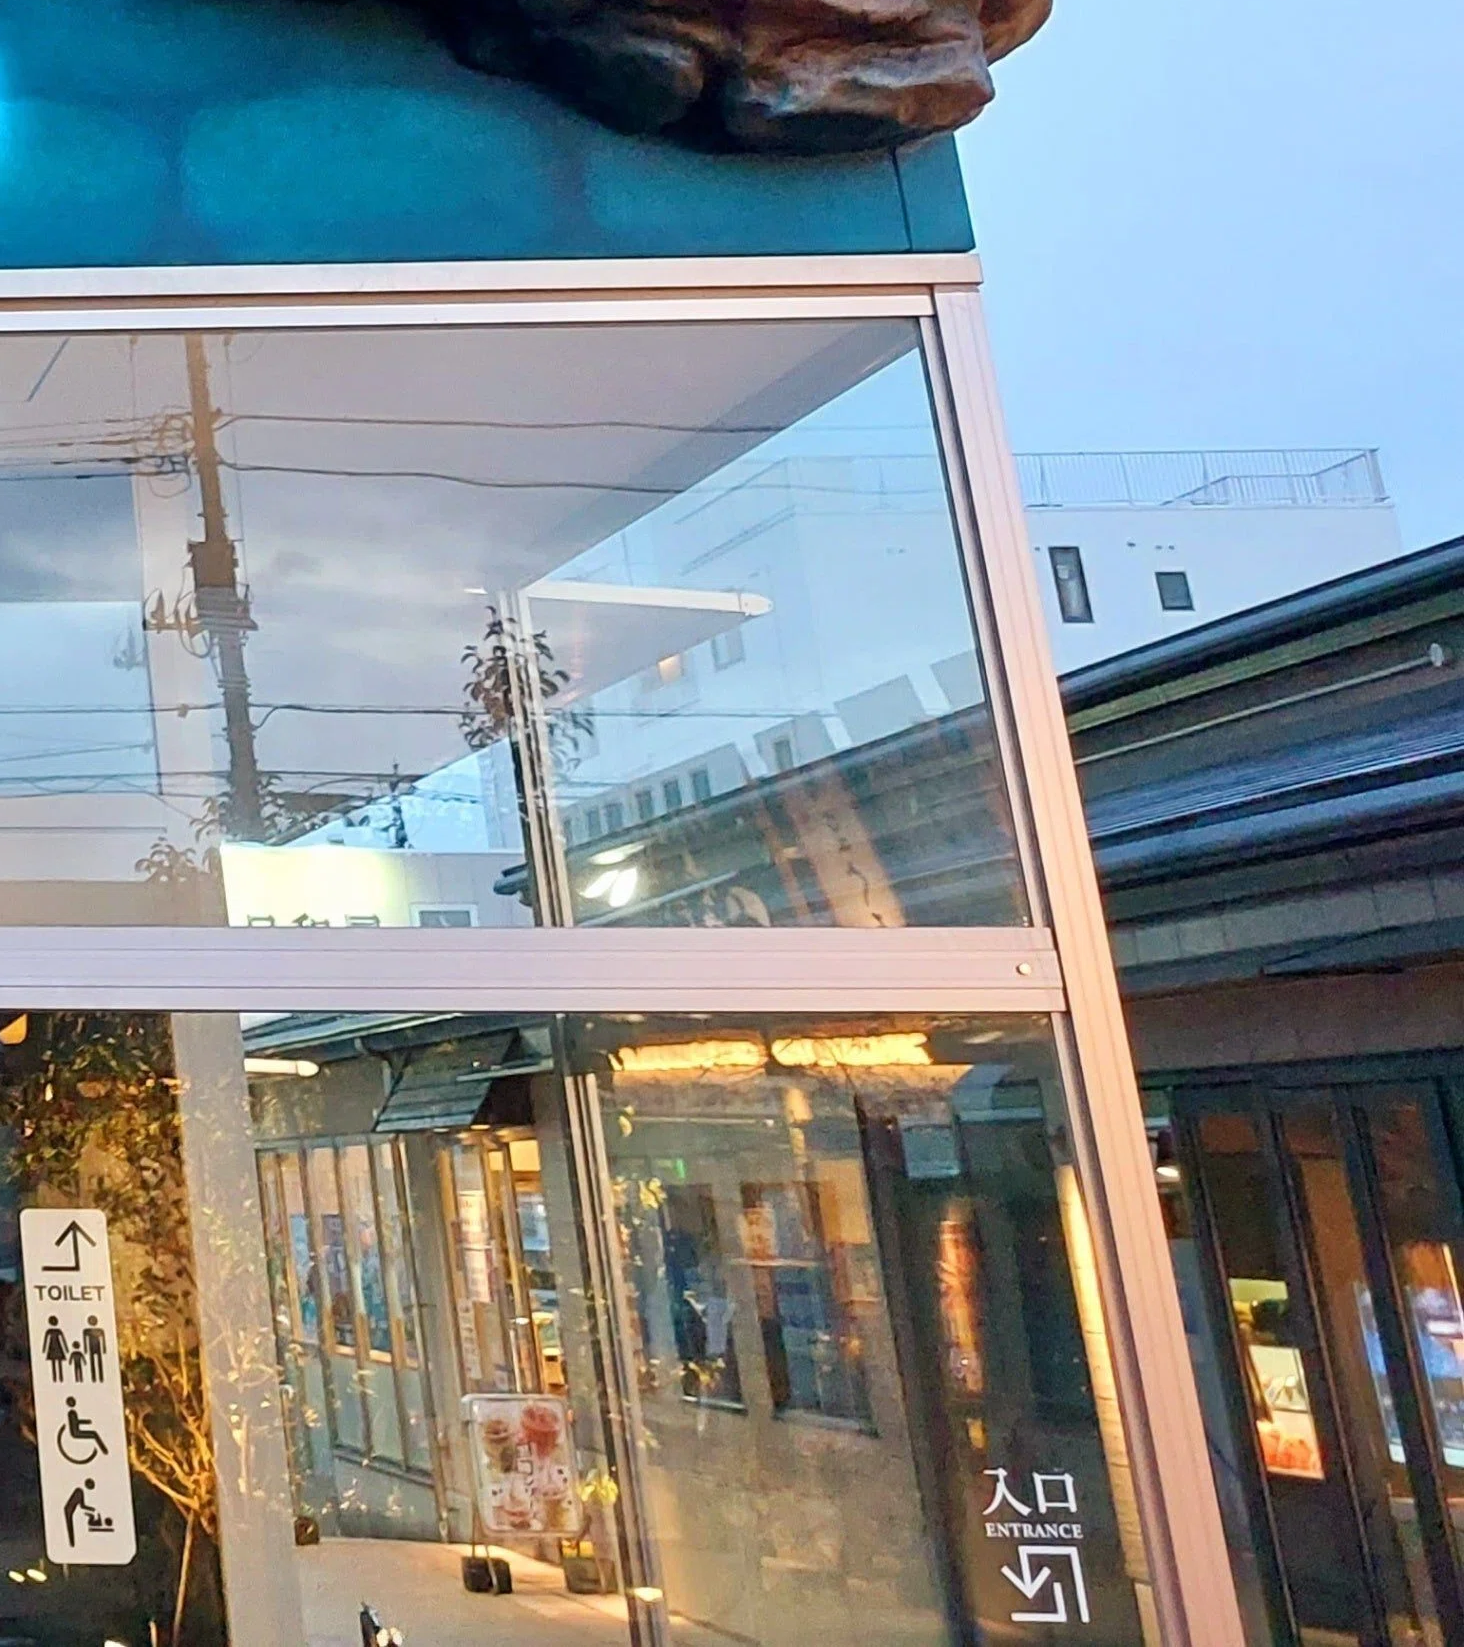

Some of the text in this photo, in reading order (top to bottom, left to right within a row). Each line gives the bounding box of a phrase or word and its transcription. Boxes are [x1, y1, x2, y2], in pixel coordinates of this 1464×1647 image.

[33, 1284, 106, 1301] TOILET
[981, 1466, 1078, 1518] 入口
[984, 1521, 1084, 1539] ENTRANCE
